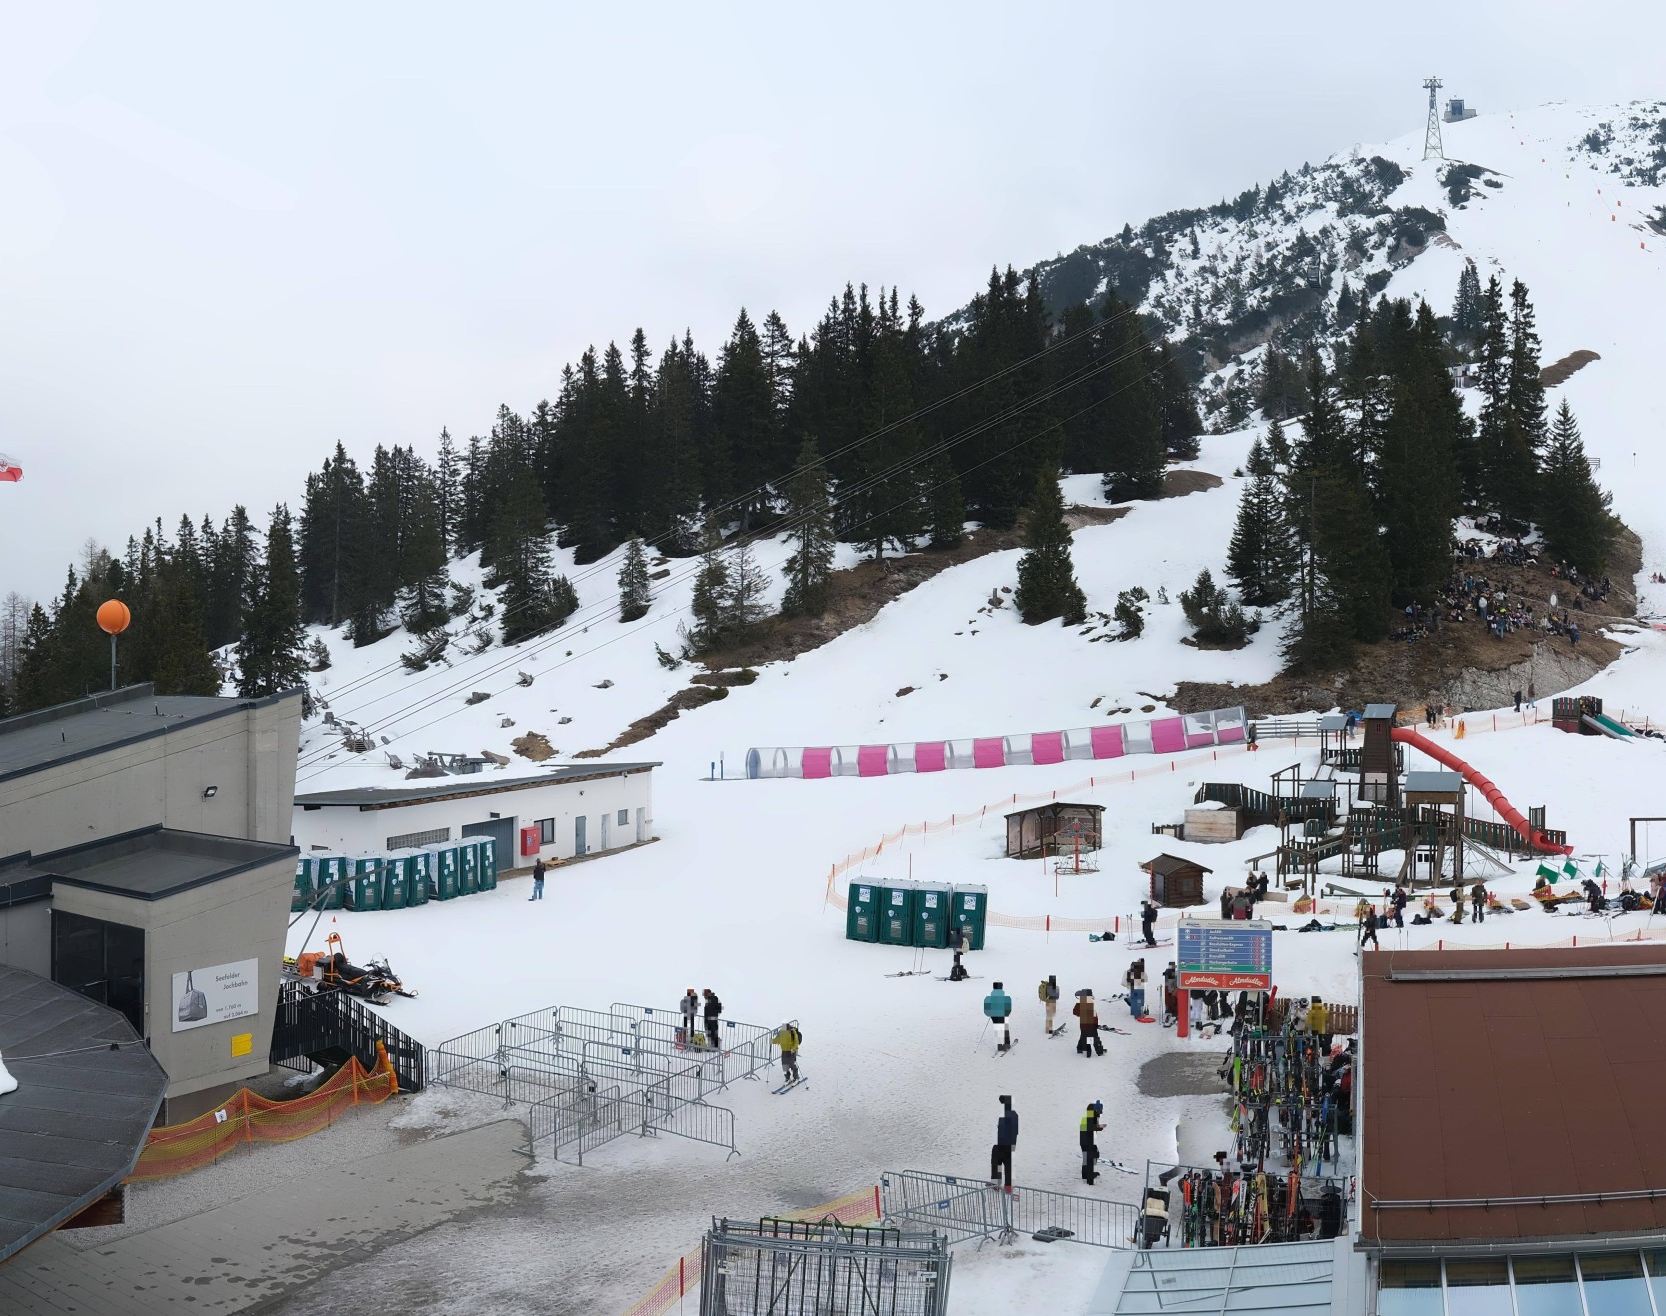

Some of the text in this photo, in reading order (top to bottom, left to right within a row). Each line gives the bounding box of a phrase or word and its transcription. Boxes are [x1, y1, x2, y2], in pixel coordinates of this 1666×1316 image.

[215, 972, 240, 982] Seefelder
[1185, 976, 1218, 985] Almdudler
[1229, 977, 1263, 986] Almdudler
[223, 980, 248, 990] Jochbahn
